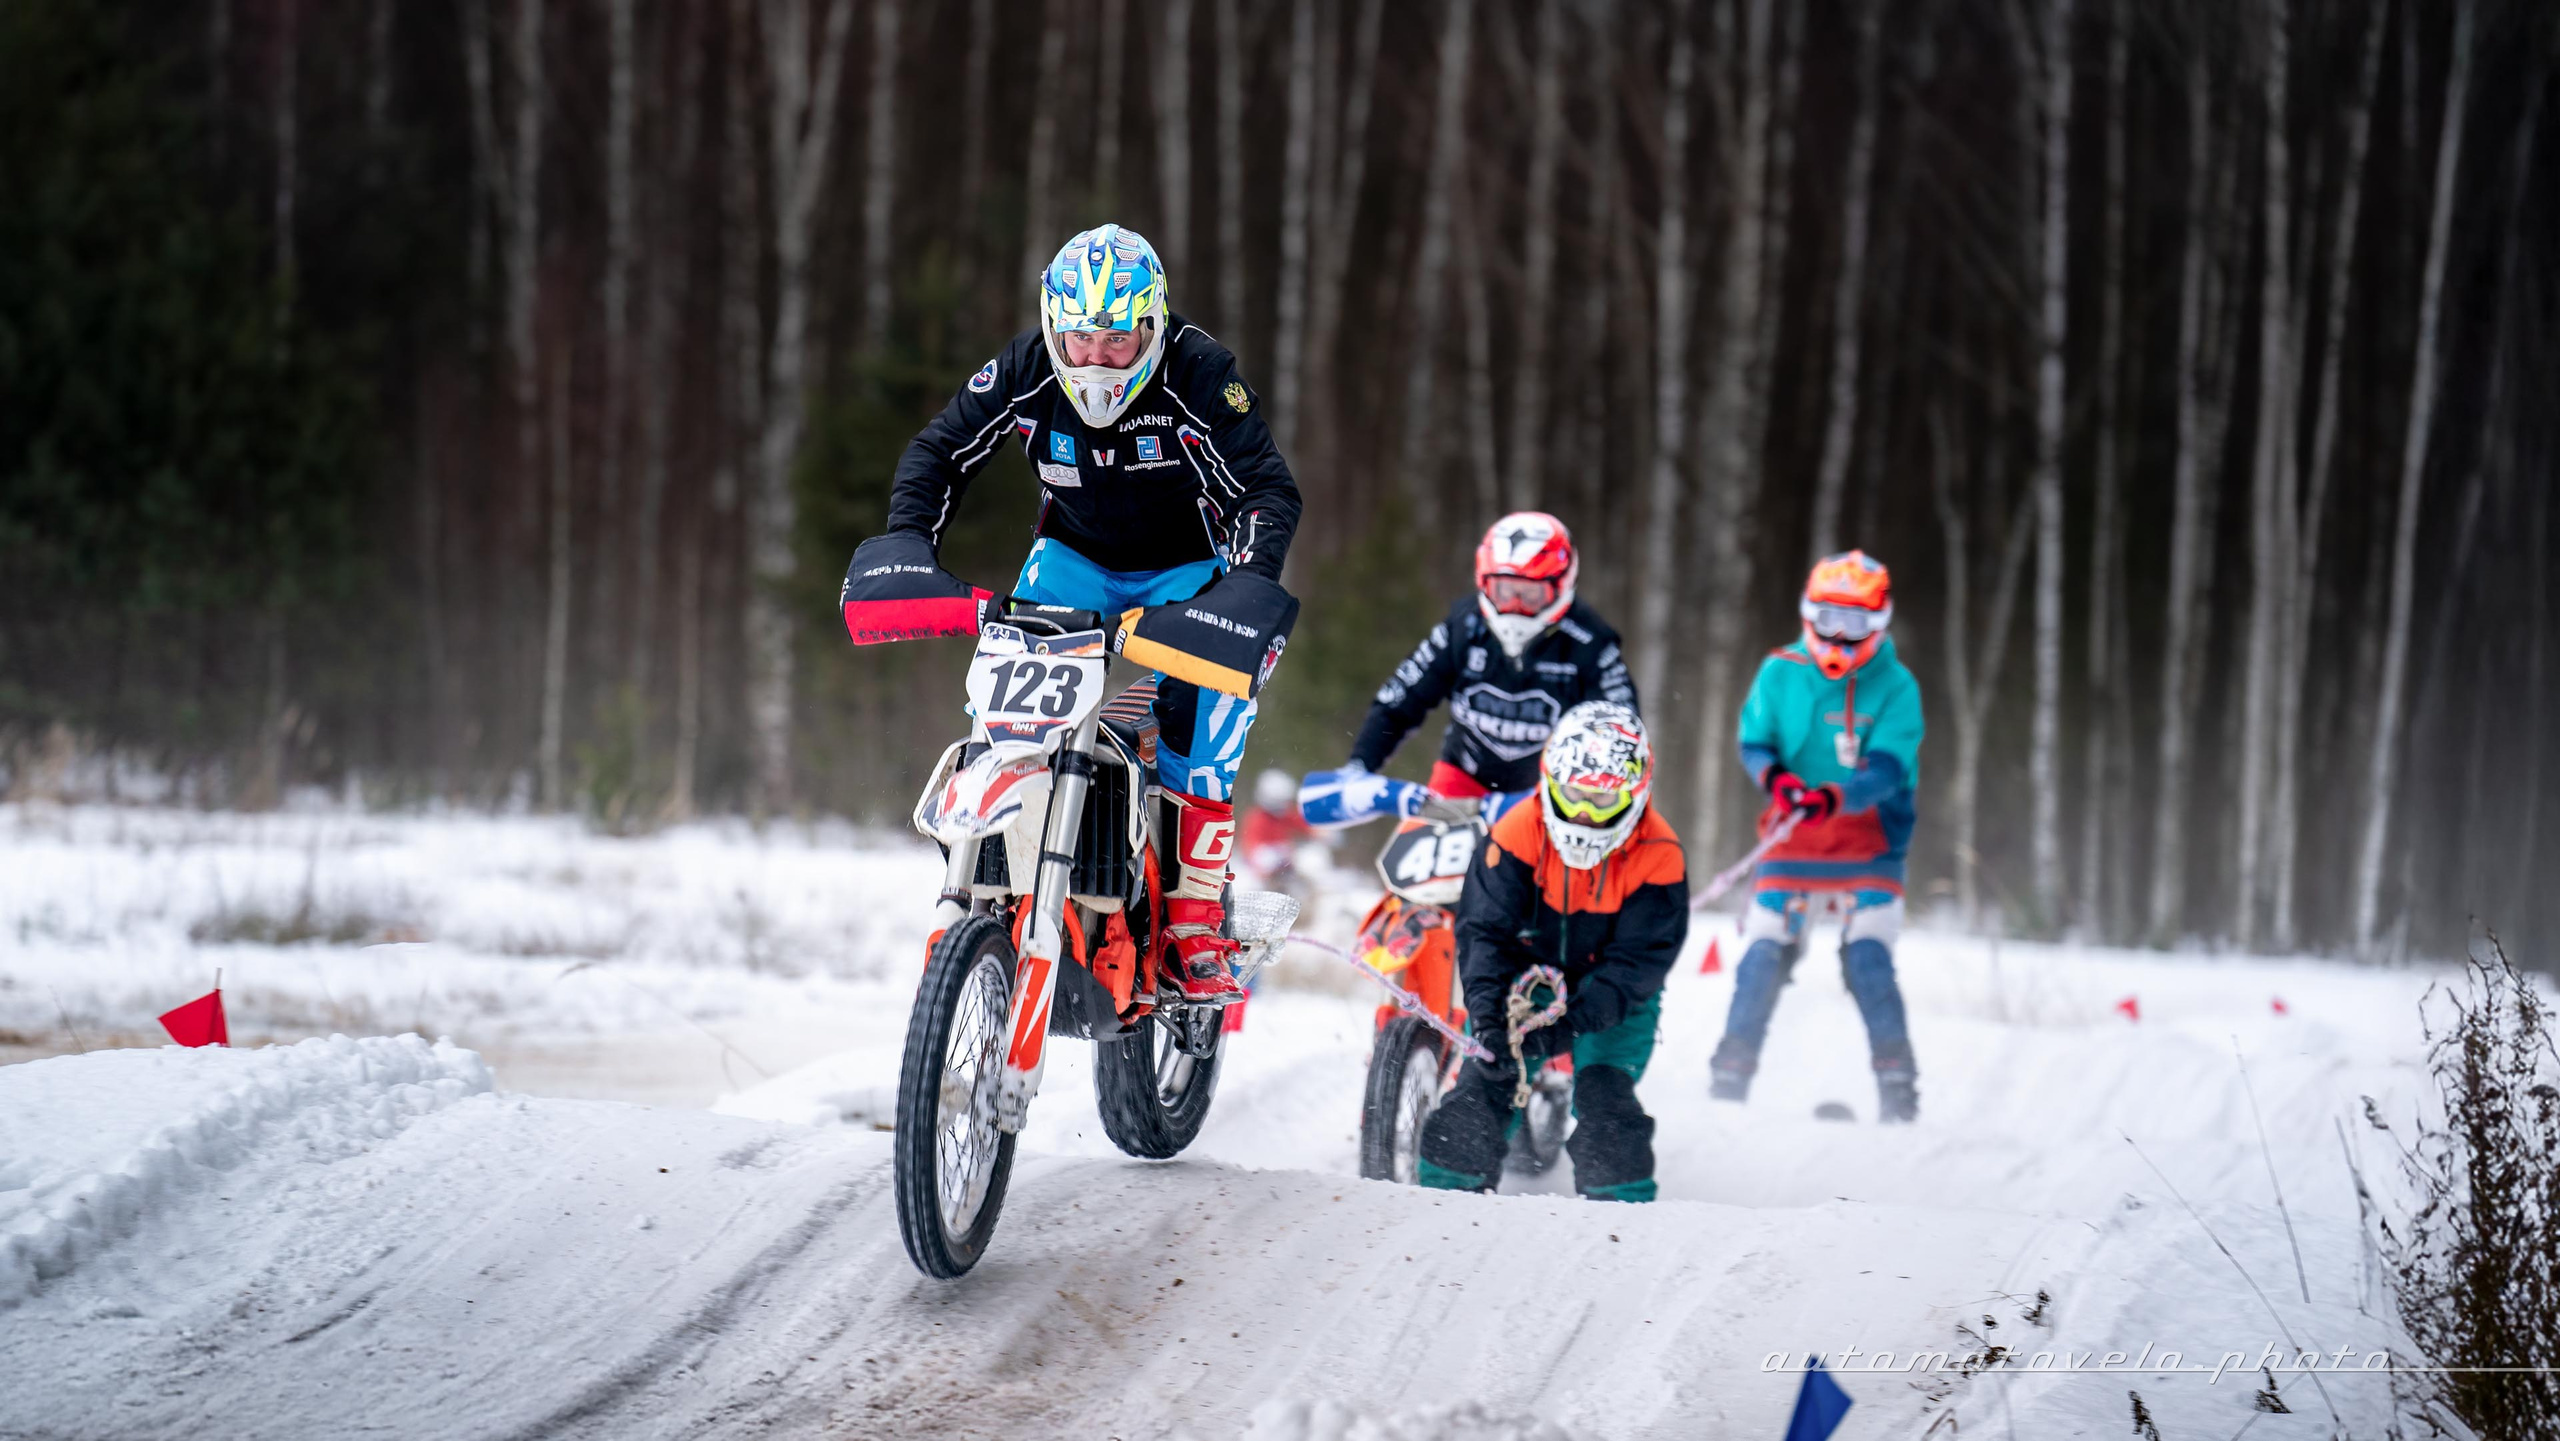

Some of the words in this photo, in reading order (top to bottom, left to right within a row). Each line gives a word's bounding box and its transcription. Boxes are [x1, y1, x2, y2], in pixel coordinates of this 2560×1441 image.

[1124, 459, 1181, 472] Rosengineering
[988, 659, 1083, 718] 123
[1395, 829, 1476, 884] 48
